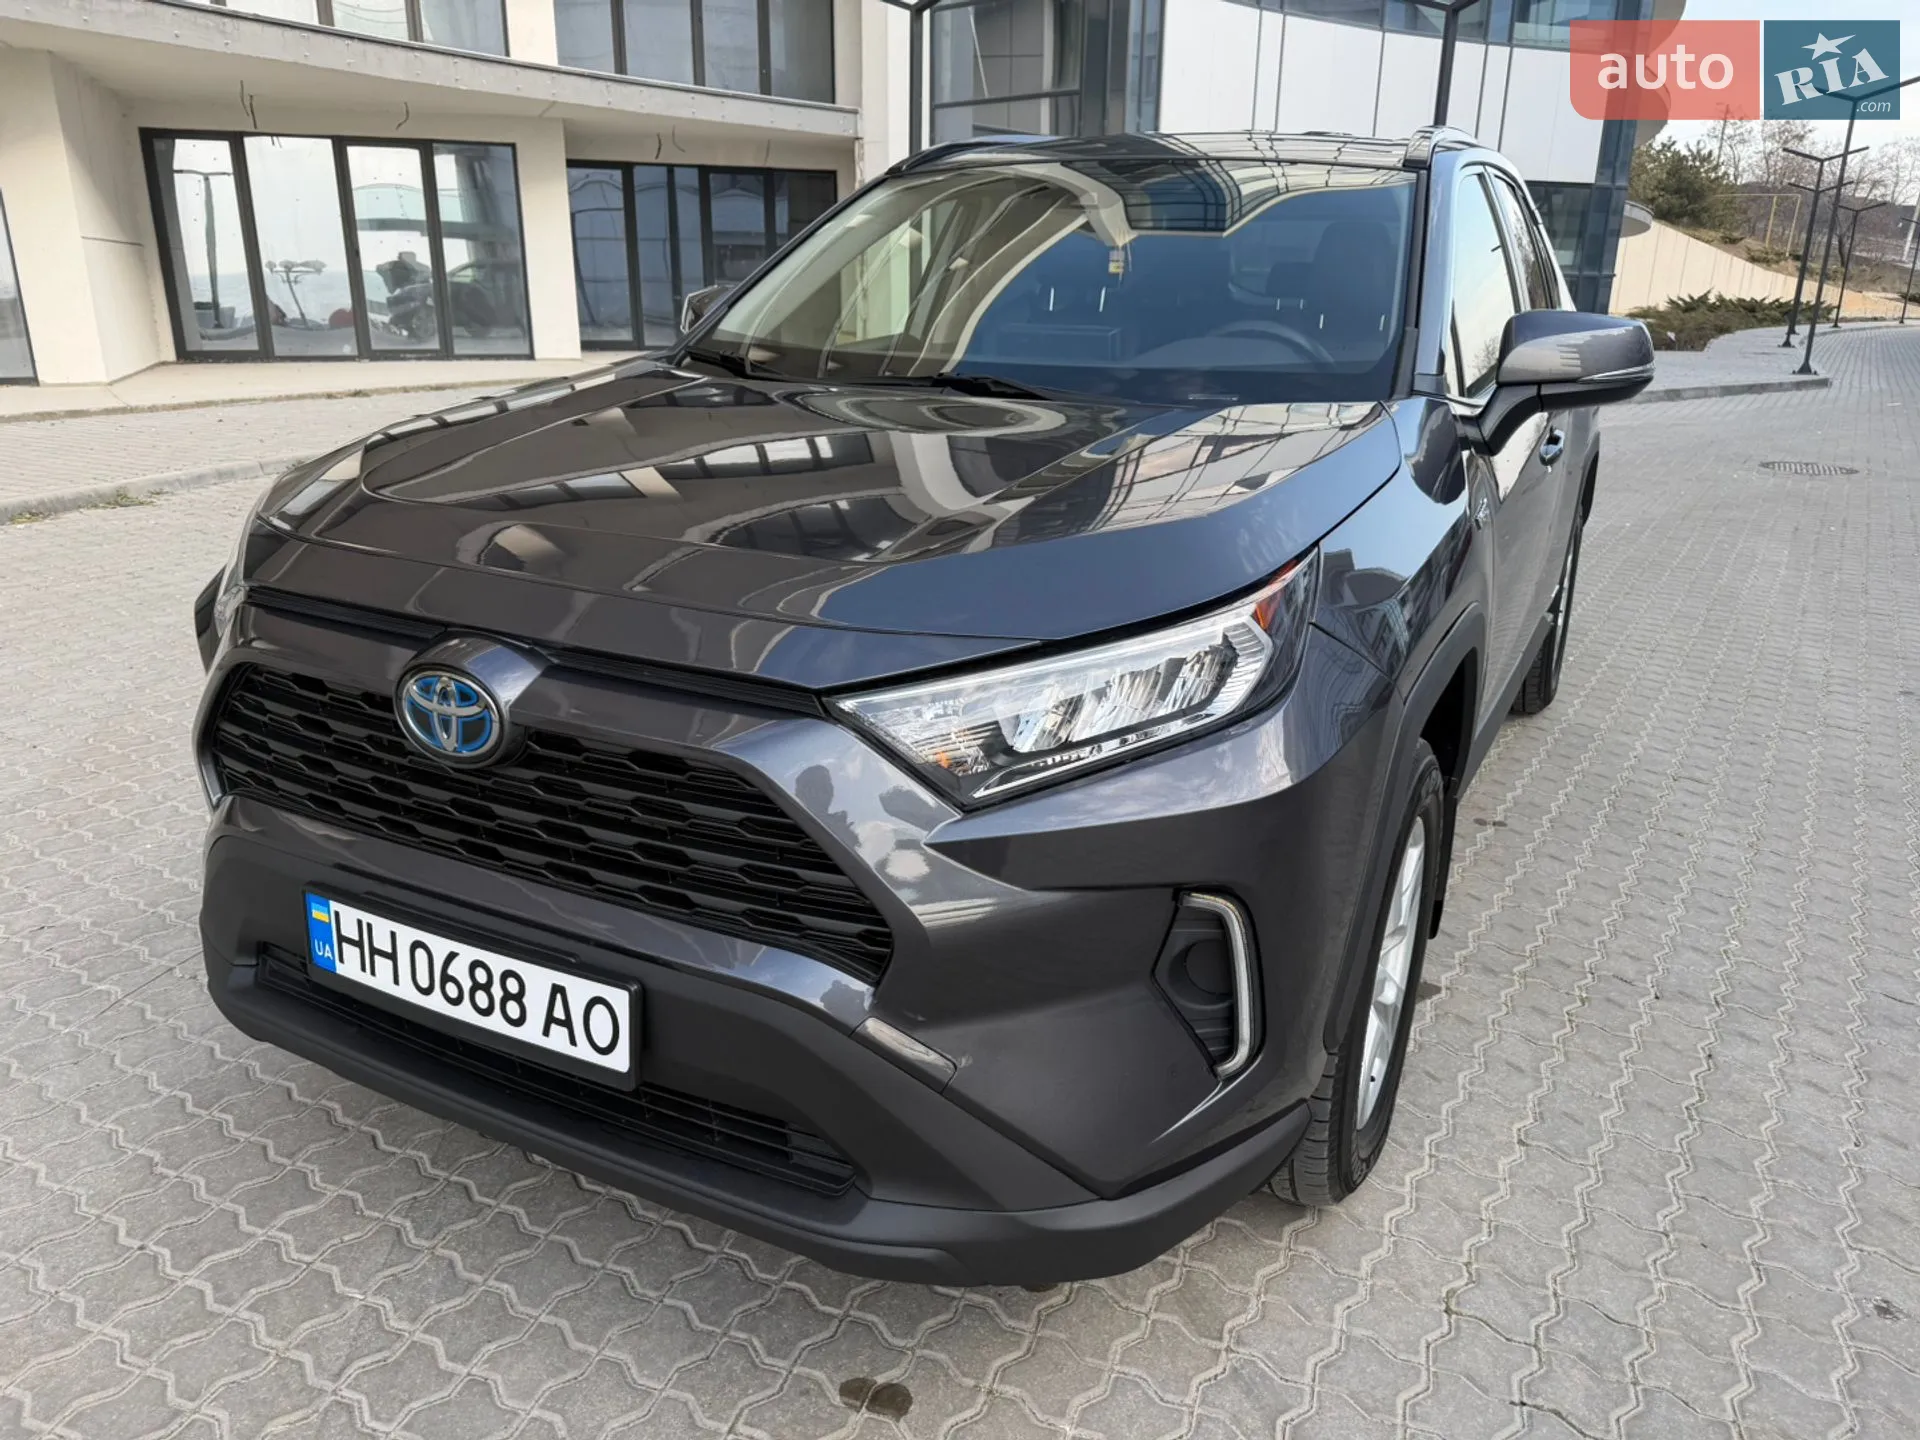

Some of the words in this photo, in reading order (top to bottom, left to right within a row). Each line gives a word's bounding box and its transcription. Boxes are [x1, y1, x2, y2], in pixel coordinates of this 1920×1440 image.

[315, 939, 333, 960] UA
[409, 939, 527, 1028] 0688
[541, 982, 620, 1056] AO
